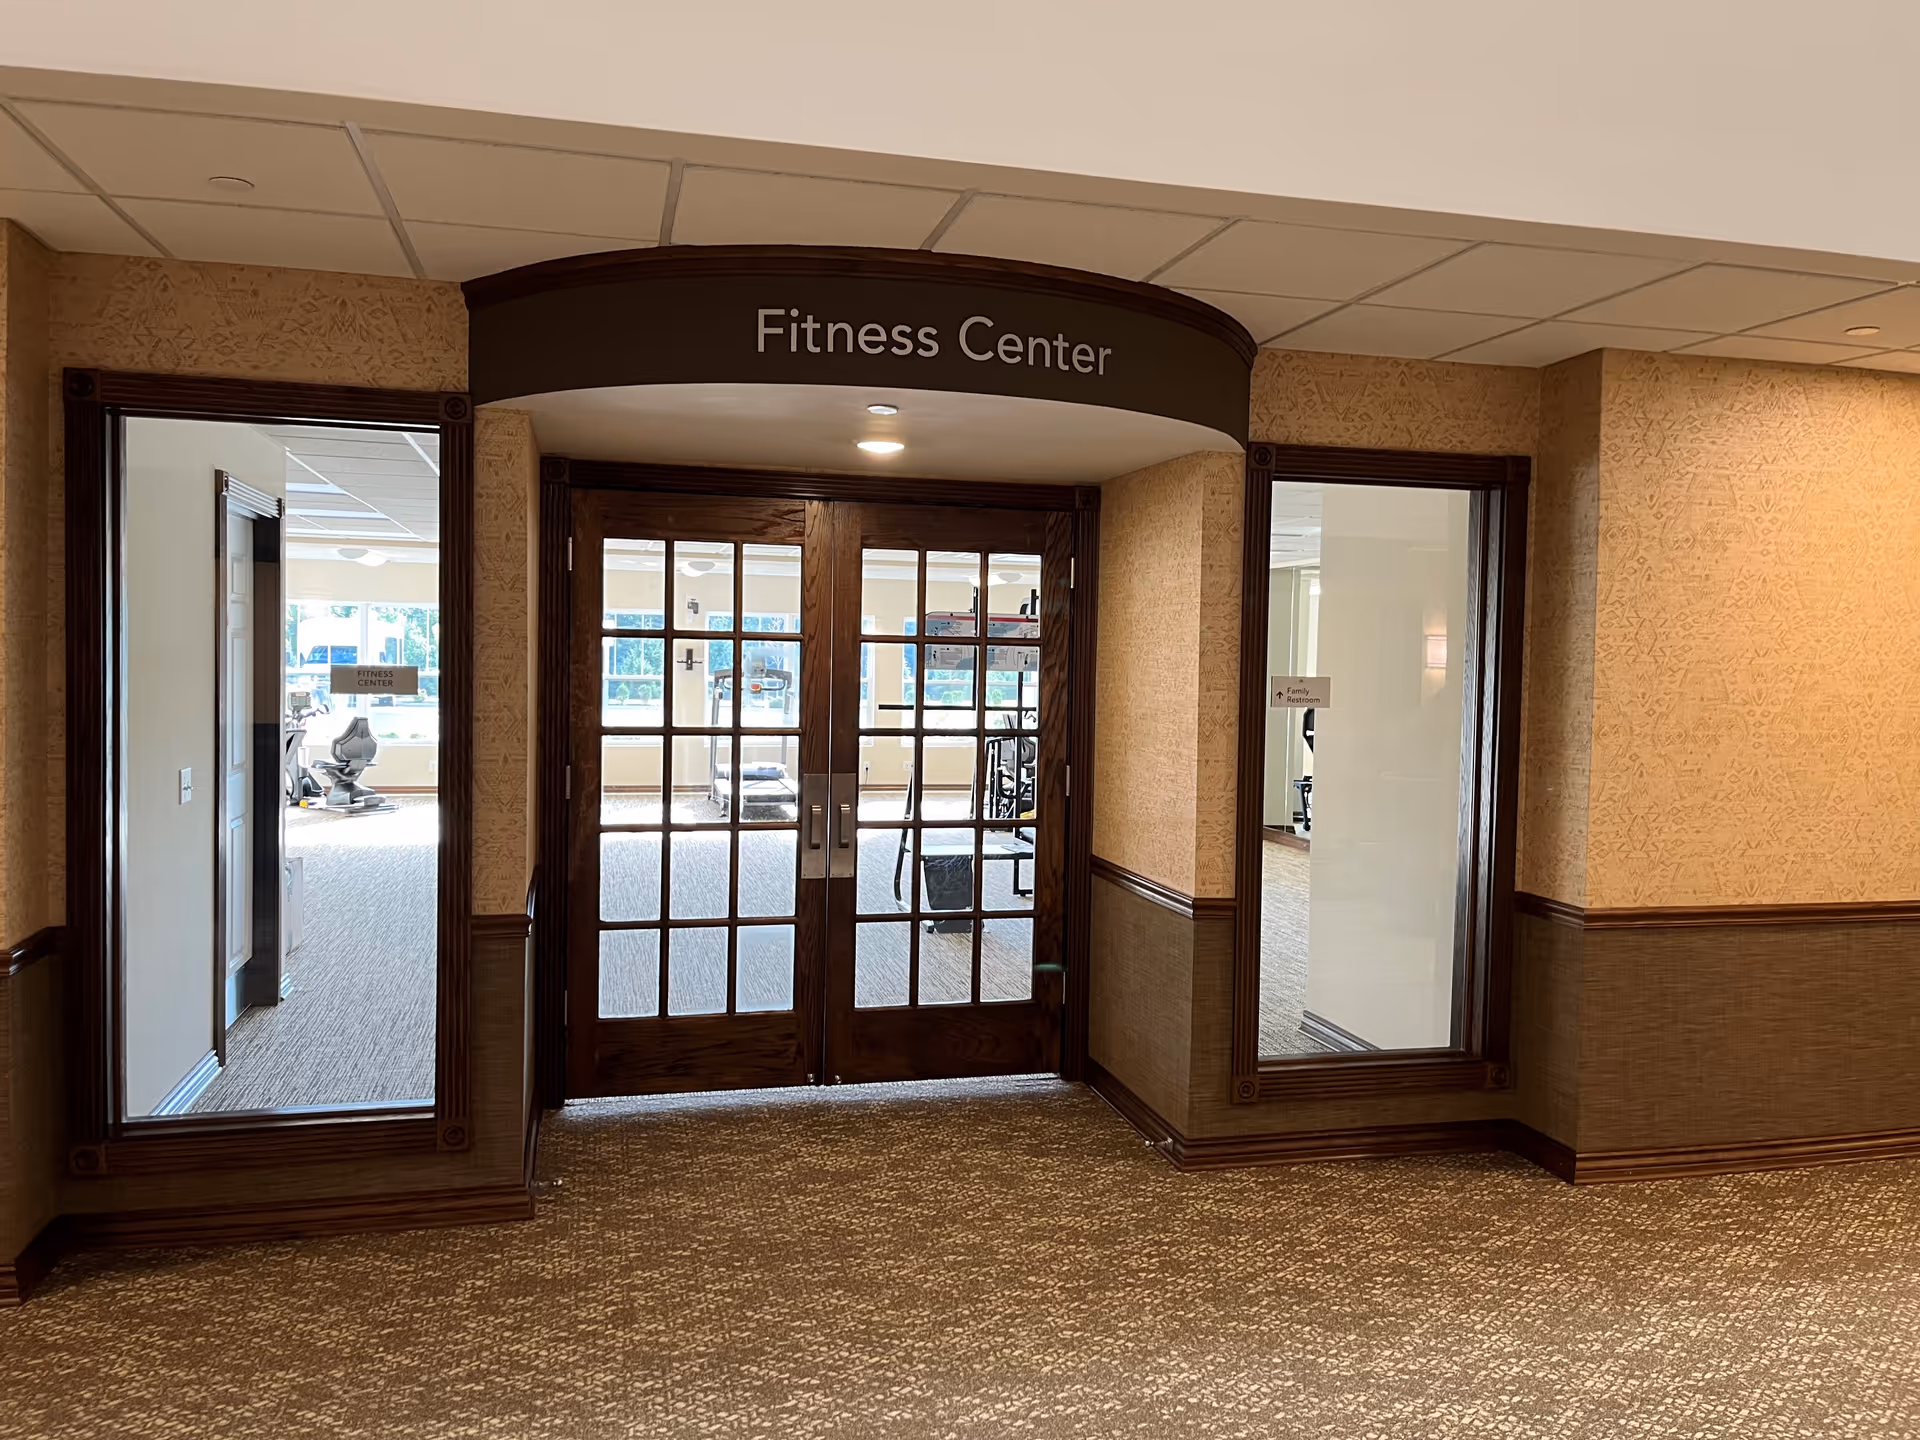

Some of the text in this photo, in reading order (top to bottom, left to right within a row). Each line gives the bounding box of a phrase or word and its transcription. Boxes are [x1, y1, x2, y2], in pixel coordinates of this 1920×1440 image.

[757, 308, 1112, 376] Fitness Center
[357, 670, 394, 678] FITNESS
[357, 679, 394, 687] CENTER
[1286, 687, 1310, 696] Family
[1286, 696, 1321, 704] Restroom
